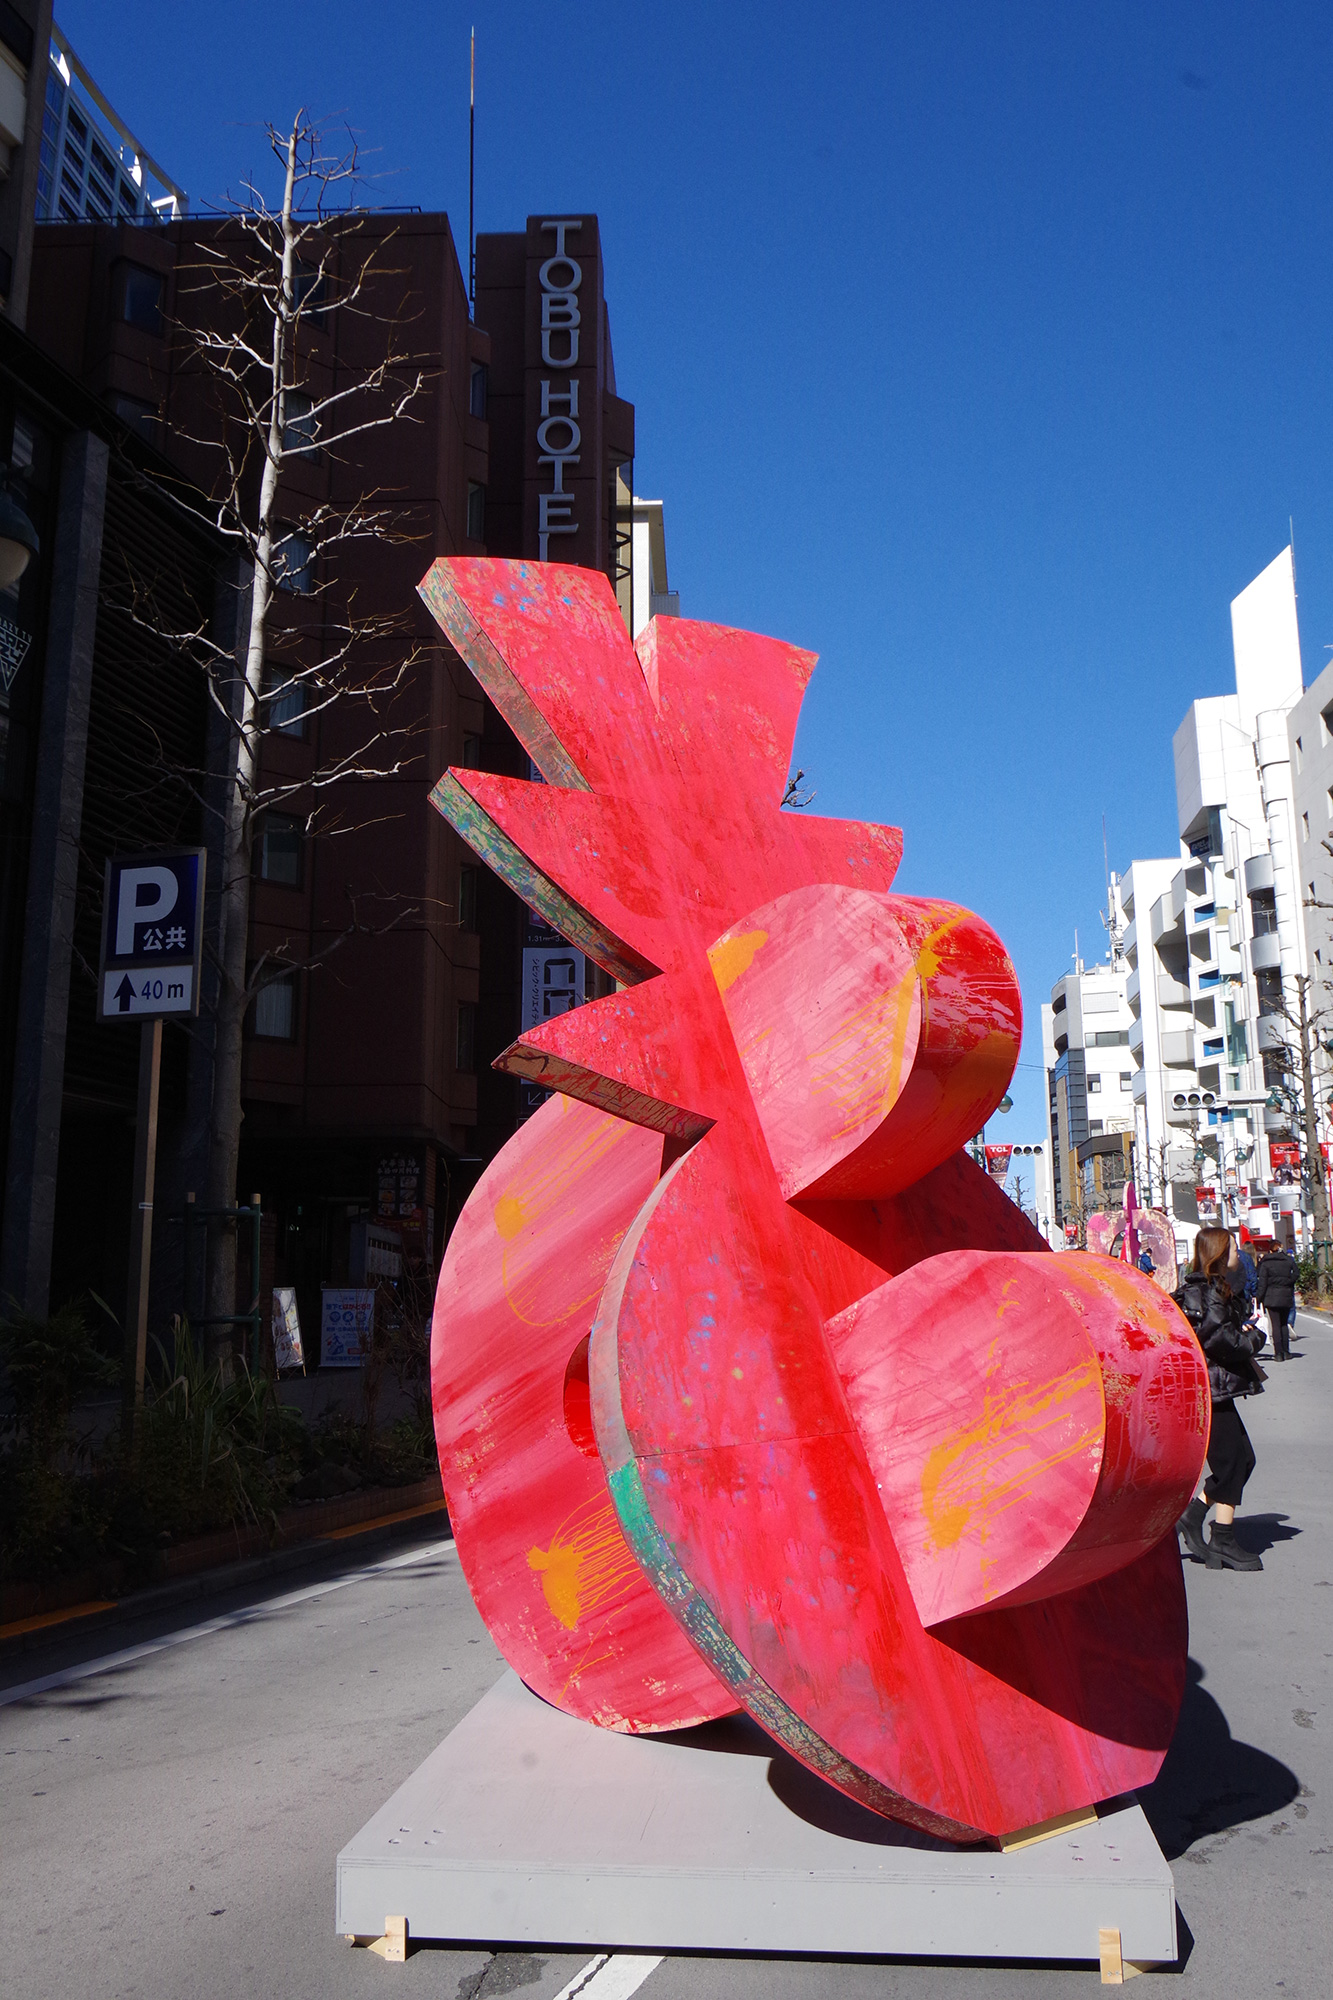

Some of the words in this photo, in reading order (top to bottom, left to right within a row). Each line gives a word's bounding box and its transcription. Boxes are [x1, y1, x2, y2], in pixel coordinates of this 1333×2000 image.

[538, 220, 583, 369] TOBU
[115, 866, 179, 955] P
[143, 926, 187, 951] 公共
